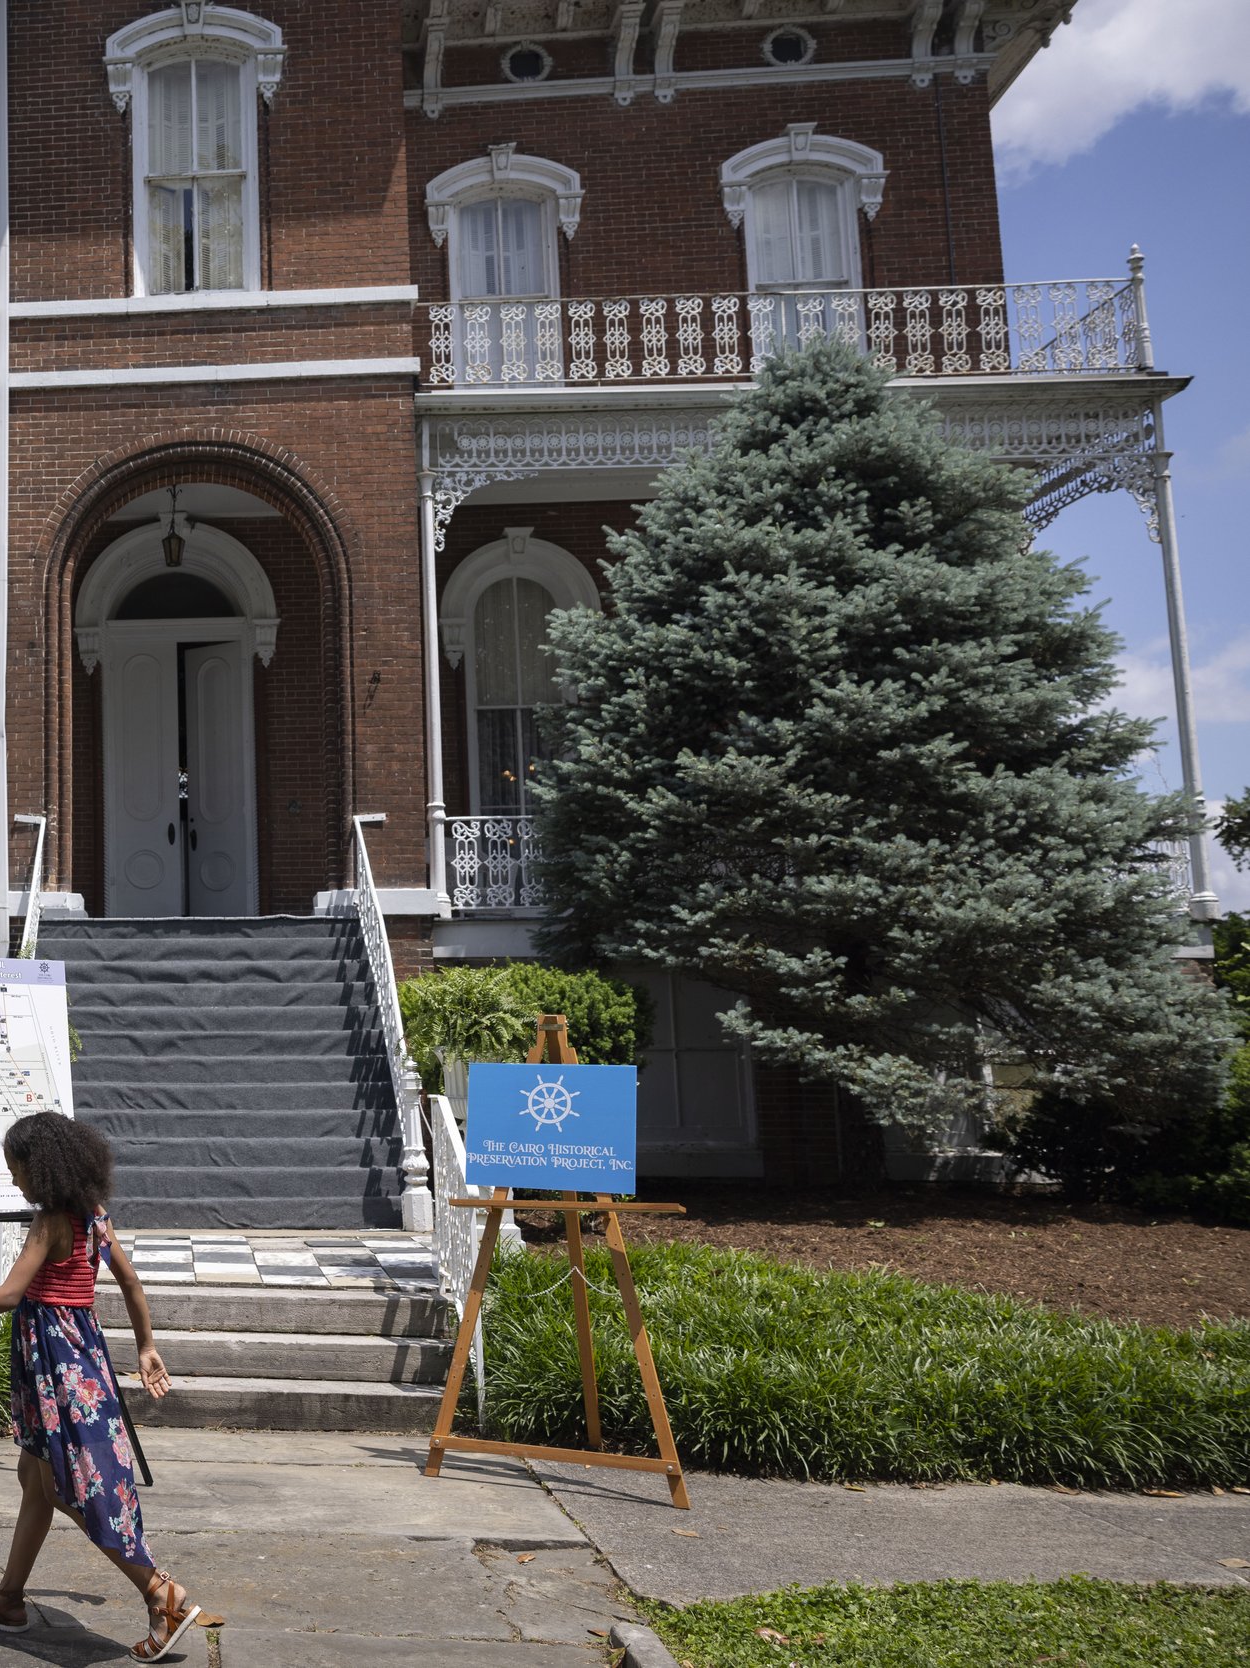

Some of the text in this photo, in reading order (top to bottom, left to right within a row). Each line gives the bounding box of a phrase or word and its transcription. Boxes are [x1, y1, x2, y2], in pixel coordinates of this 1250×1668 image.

[0, 960, 6, 969] IL
[26, 1094, 33, 1102] B
[482, 1139, 616, 1158] THE CAIRO HISTORICAL
[466, 1152, 634, 1171] PRESERVATION PROJECT, INC.
